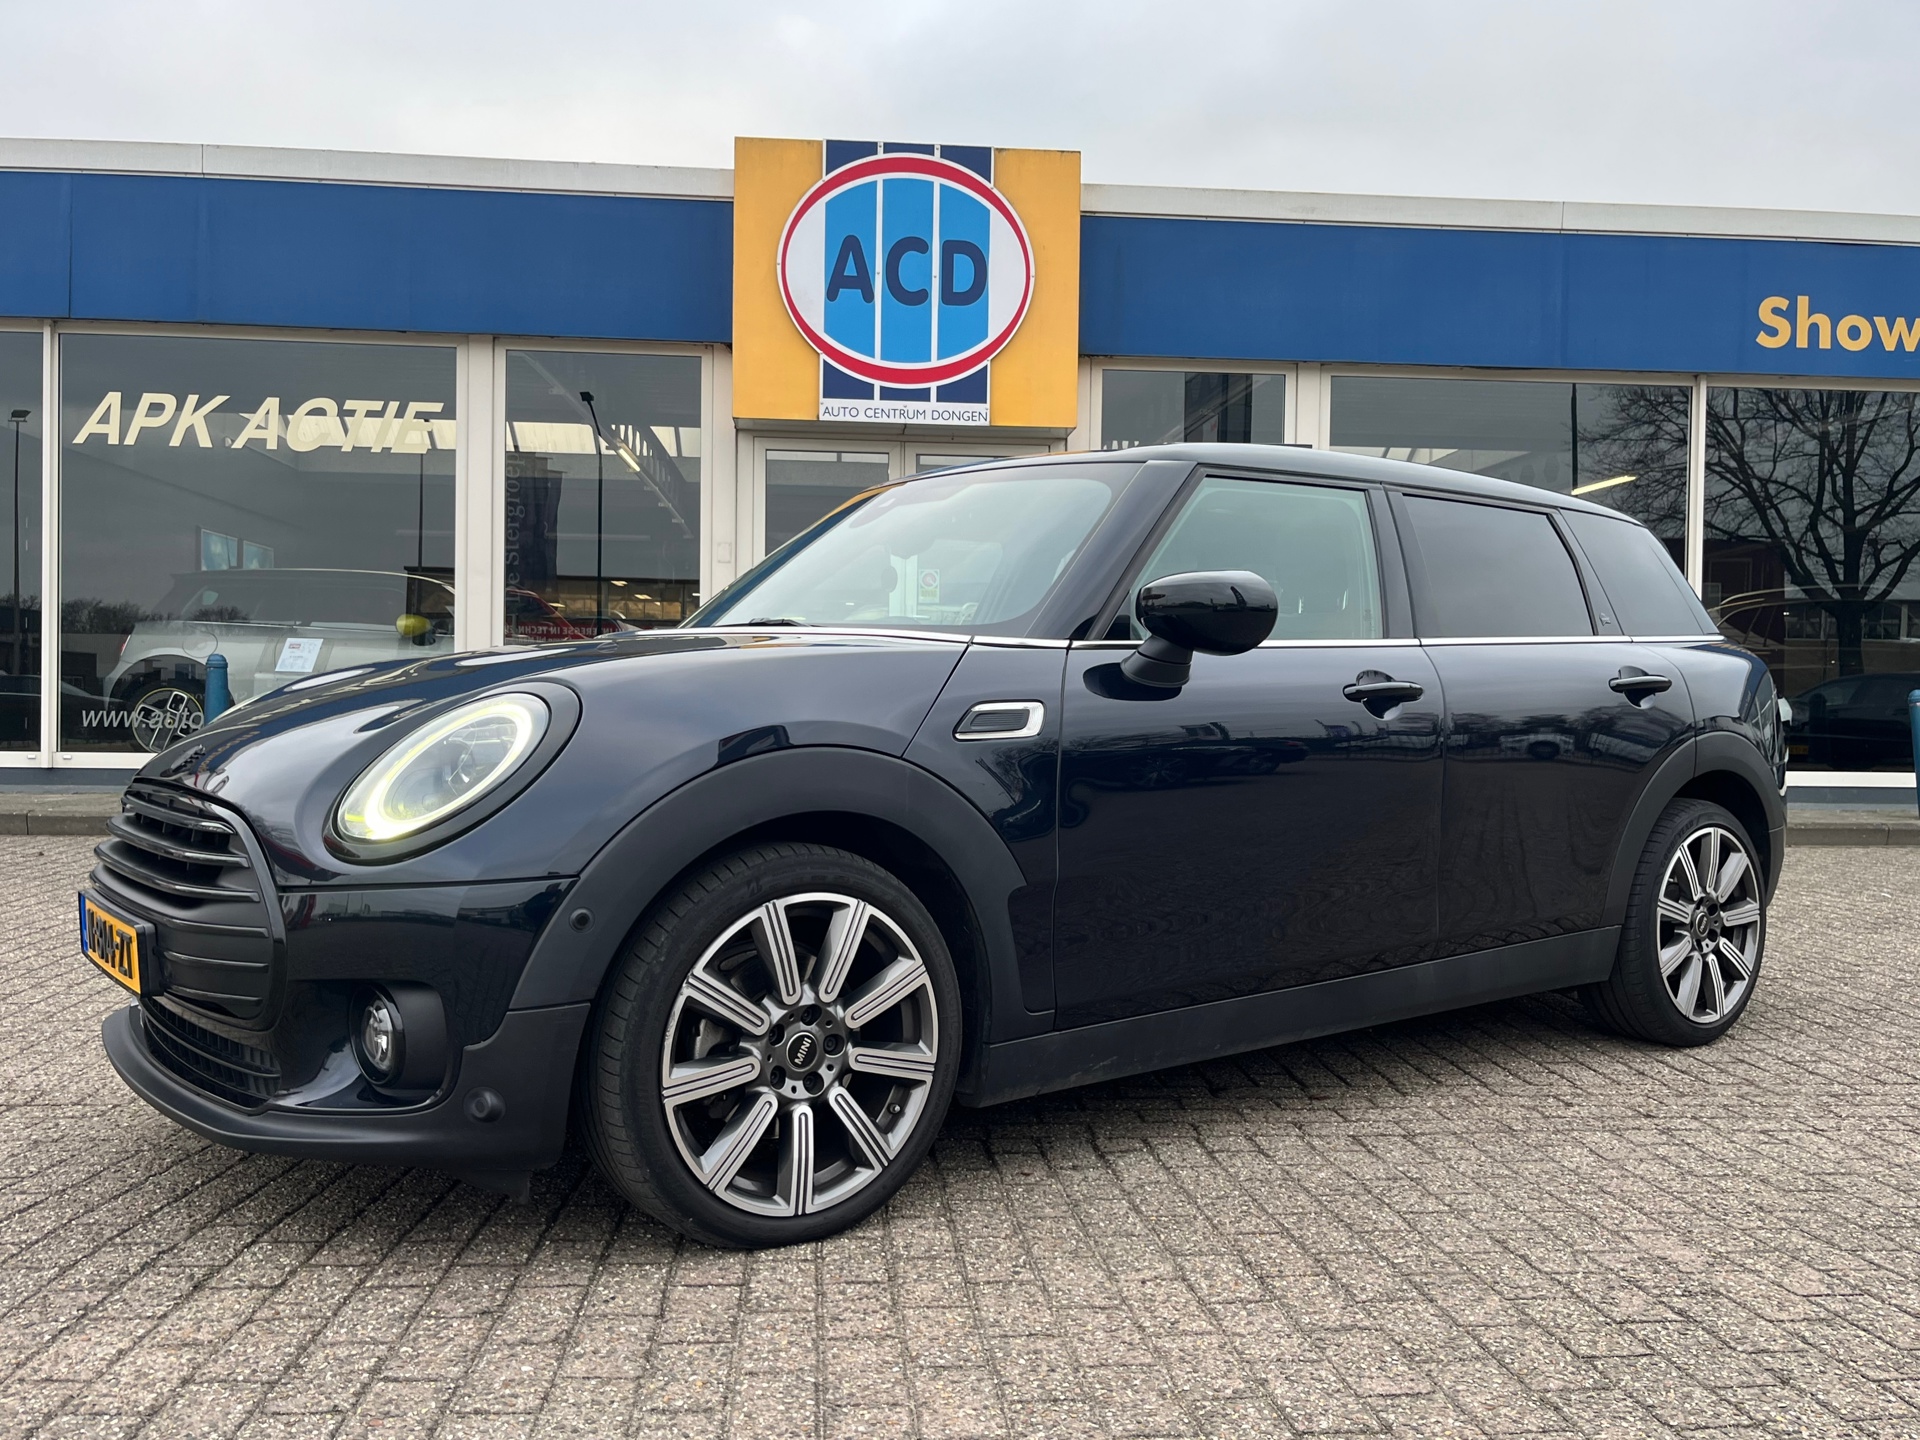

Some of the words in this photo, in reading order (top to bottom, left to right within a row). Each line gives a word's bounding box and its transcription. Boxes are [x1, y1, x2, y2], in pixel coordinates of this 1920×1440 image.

[826, 234, 989, 307] ACD
[1756, 295, 1920, 352] Show
[72, 391, 231, 448] APK
[231, 397, 445, 454] ACTIE
[822, 406, 860, 419] AUTO
[864, 407, 927, 421] CENTRUM
[931, 408, 989, 422] DONGEN
[794, 1037, 812, 1065] MINI
